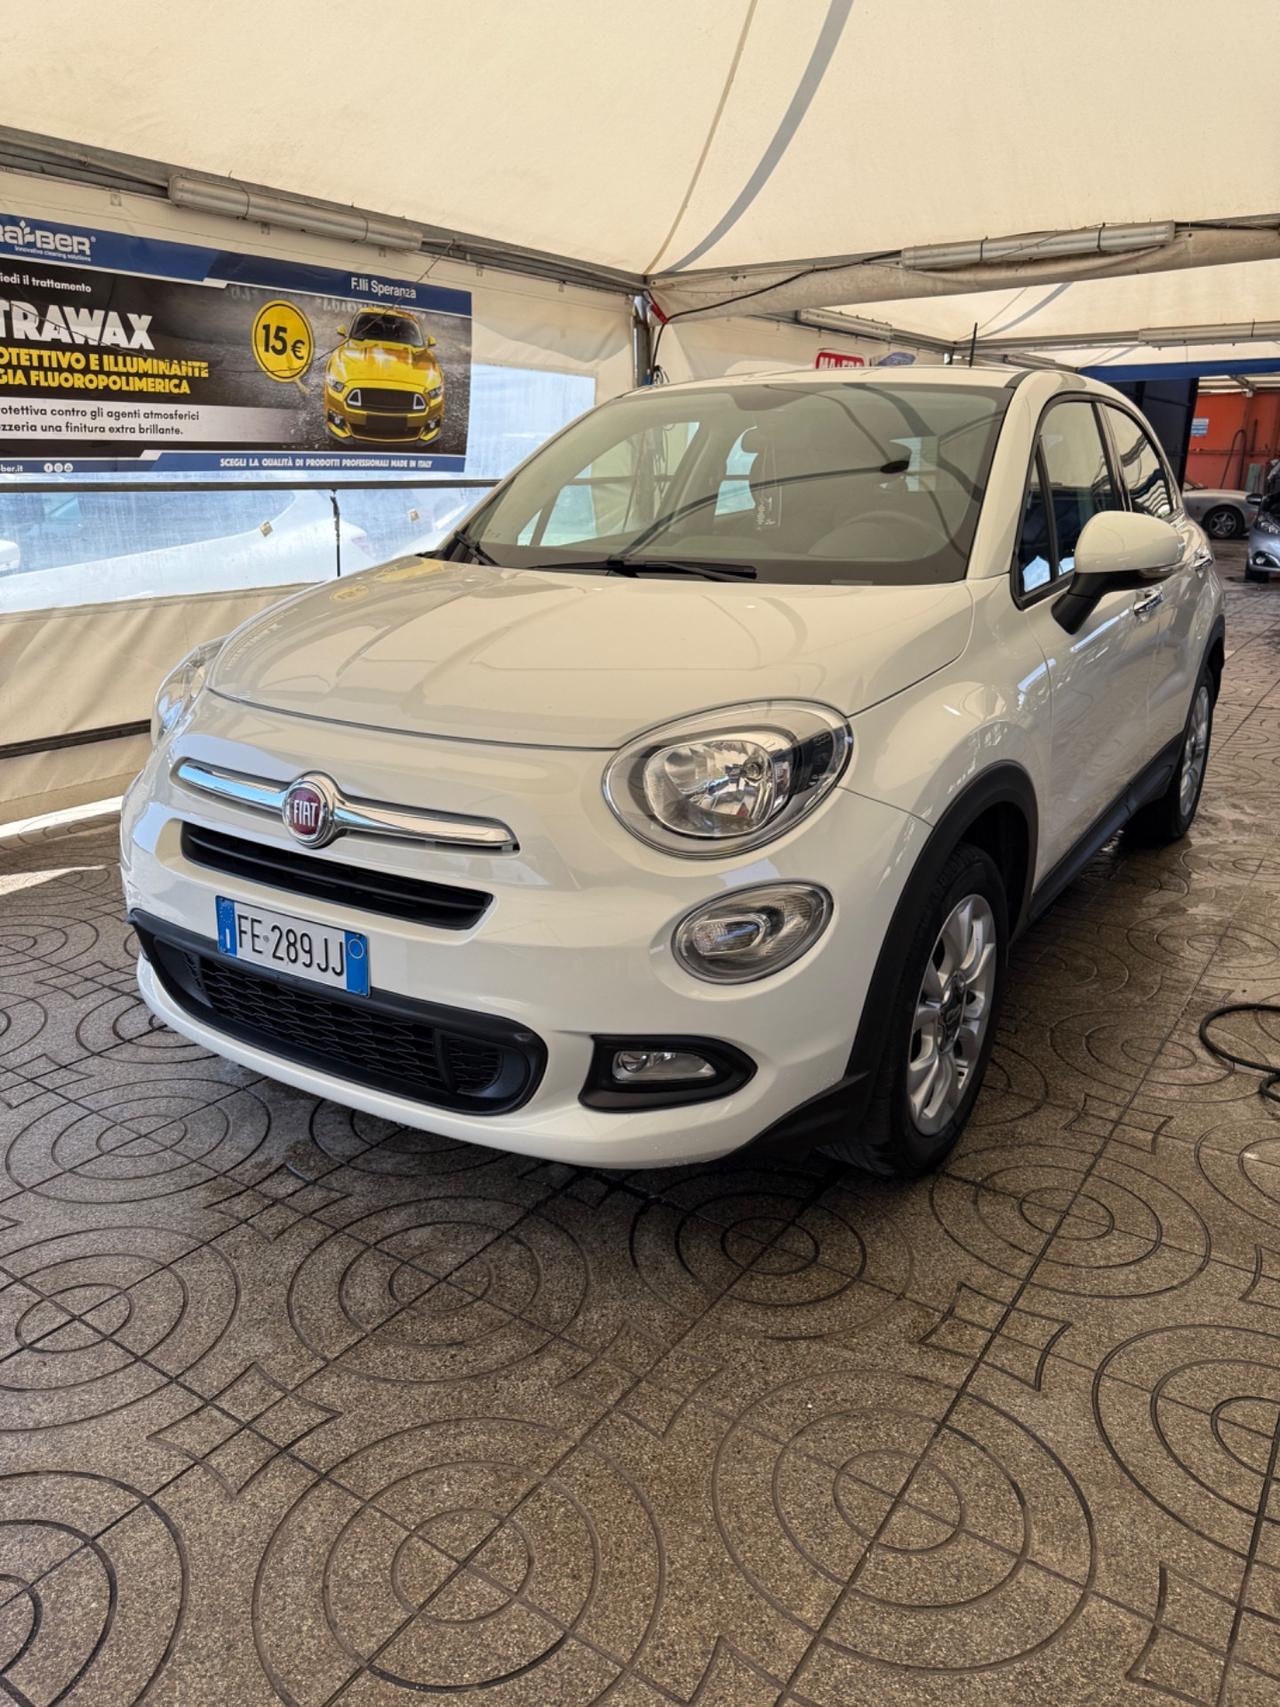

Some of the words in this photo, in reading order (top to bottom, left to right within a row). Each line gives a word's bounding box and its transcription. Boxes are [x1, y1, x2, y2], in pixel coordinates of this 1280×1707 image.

[22, 274, 30, 286] il
[31, 277, 92, 293] trattamento
[370, 280, 417, 299] Speranza
[89, 353, 100, 371] E
[102, 354, 209, 378] ILLUMINANTE
[30, 370, 191, 394] FLUOROPOLIMERICA
[50, 407, 87, 417] contro
[90, 406, 104, 420] gli
[106, 409, 141, 421] agenti
[143, 409, 200, 421] atmosferici
[0, 421, 37, 432] zzeria
[40, 424, 62, 433] una
[65, 421, 106, 433] finitura
[108, 425, 136, 434] extra
[138, 423, 183, 435] brillante.
[220, 457, 247, 467] SCEGLI
[248, 458, 259, 467] LA
[295, 457, 304, 467] DI
[305, 458, 340, 468] PRODOTTI
[409, 459, 417, 468] IN
[293, 799, 318, 827] FIAT
